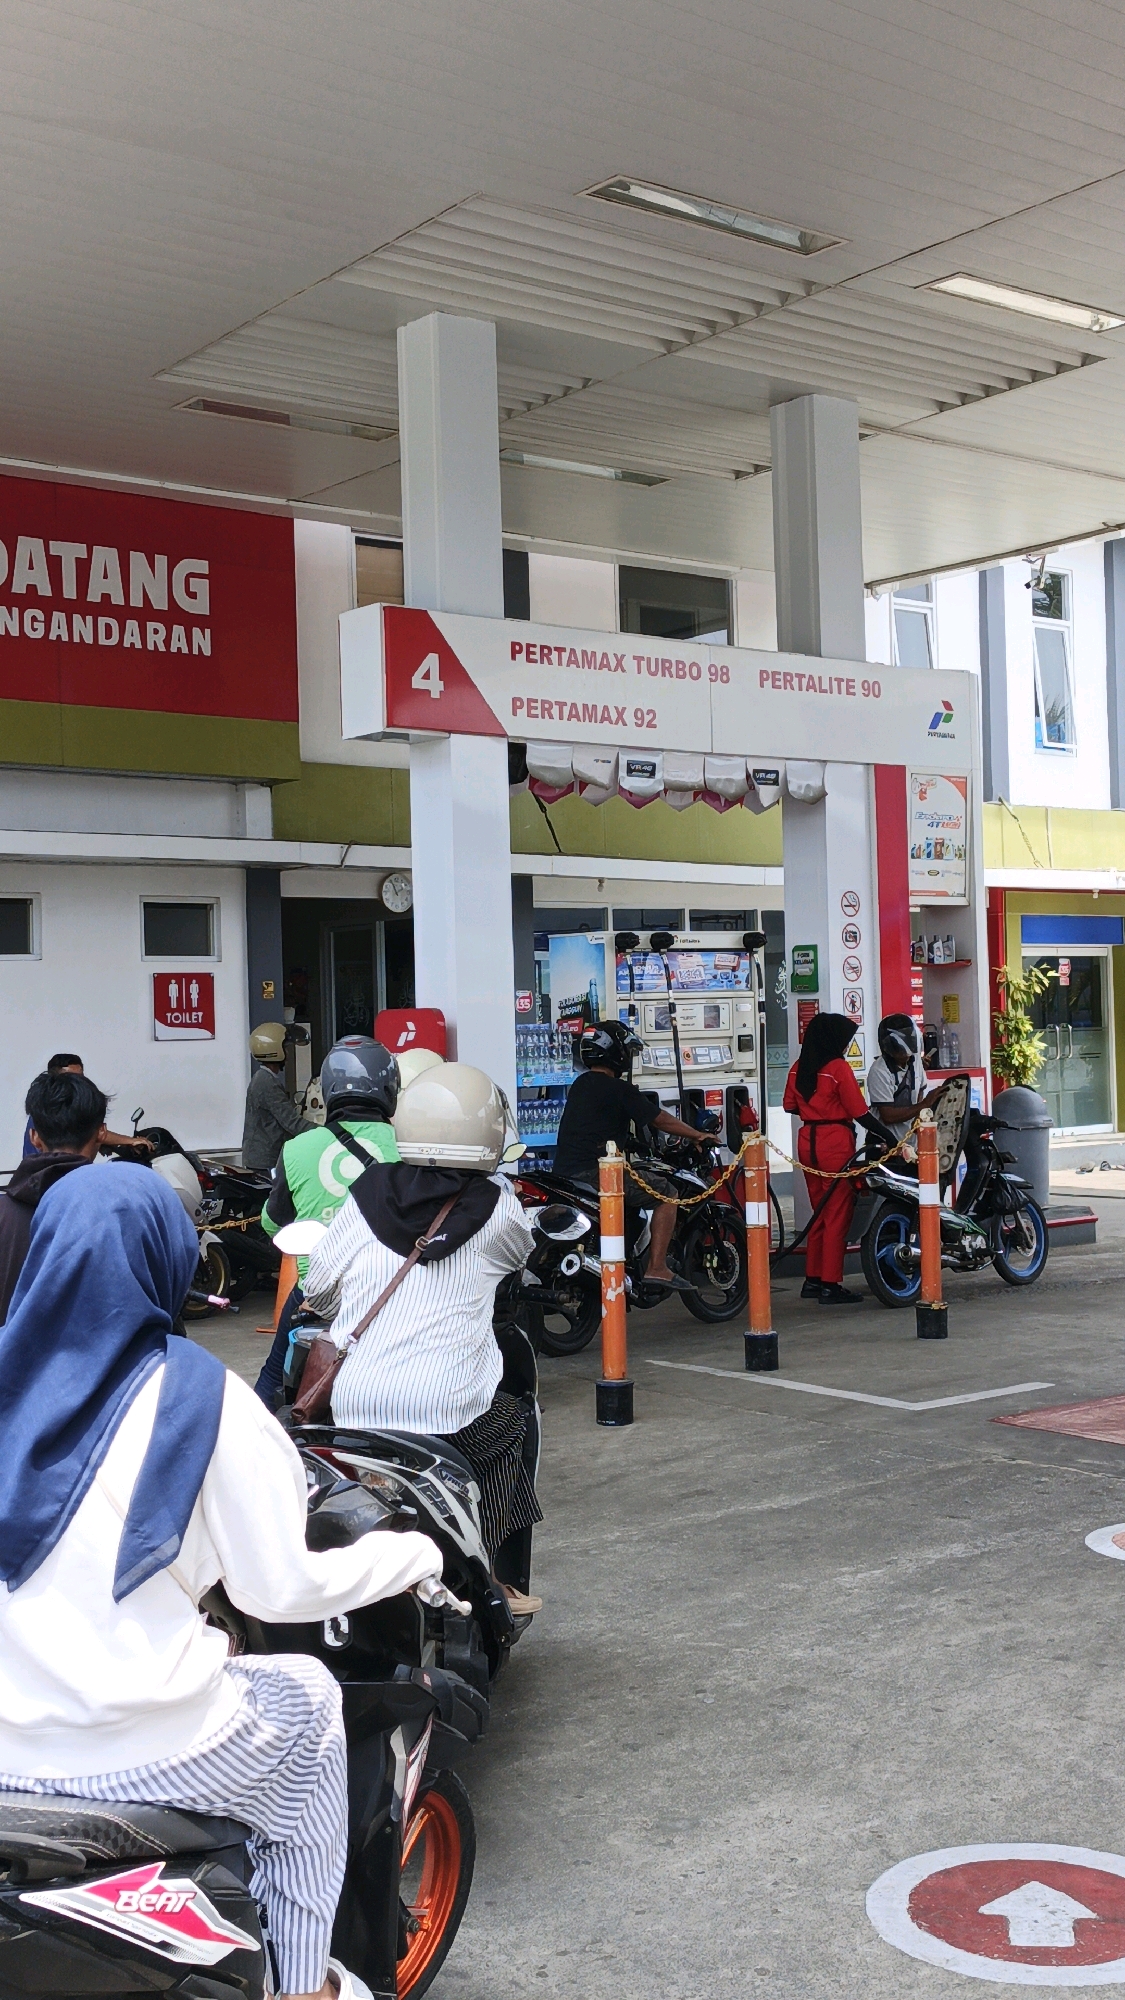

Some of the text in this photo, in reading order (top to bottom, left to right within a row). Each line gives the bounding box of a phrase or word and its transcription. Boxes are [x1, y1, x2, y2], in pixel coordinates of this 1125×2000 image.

[0, 534, 210, 615] ATANG
[0, 605, 212, 656] NGANDARAN
[411, 652, 445, 699] 4
[510, 641, 731, 684] PERTAMAX TURBO 98
[758, 669, 882, 698] PERTALITE 90
[511, 697, 658, 729] PERTAMAX 92
[166, 1011, 204, 1024] TOILET
[114, 1889, 197, 1914] BeAT
